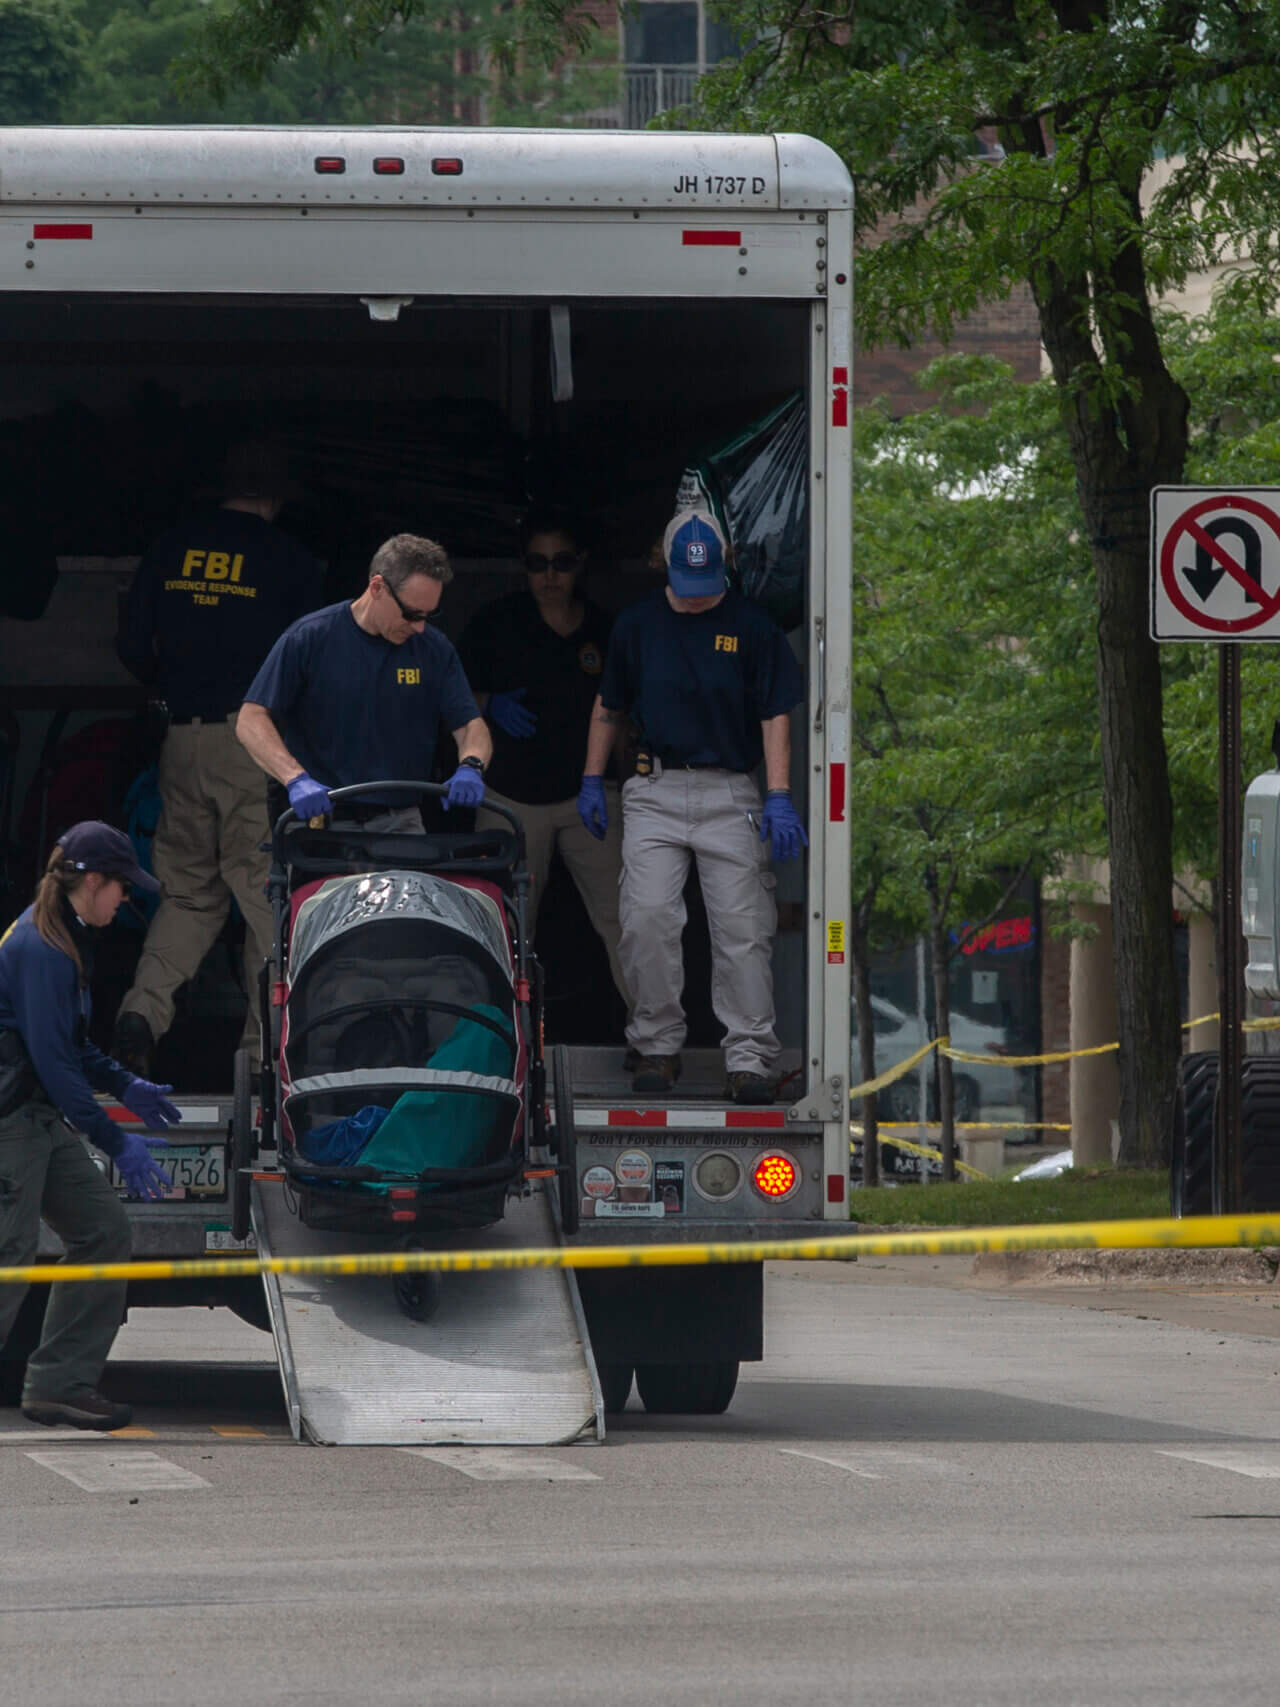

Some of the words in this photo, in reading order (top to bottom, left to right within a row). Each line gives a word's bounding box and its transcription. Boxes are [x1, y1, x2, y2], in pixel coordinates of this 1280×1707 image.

[673, 175, 698, 194] JH
[704, 176, 747, 195] 1737
[751, 176, 766, 195] D
[690, 545, 704, 555] 93
[182, 549, 244, 582] FBI
[164, 580, 207, 592] EVIDENCE
[208, 582, 257, 598] RESPONSE
[192, 593, 220, 606] TEAM
[715, 634, 738, 652] FBI
[396, 668, 421, 685] FBI
